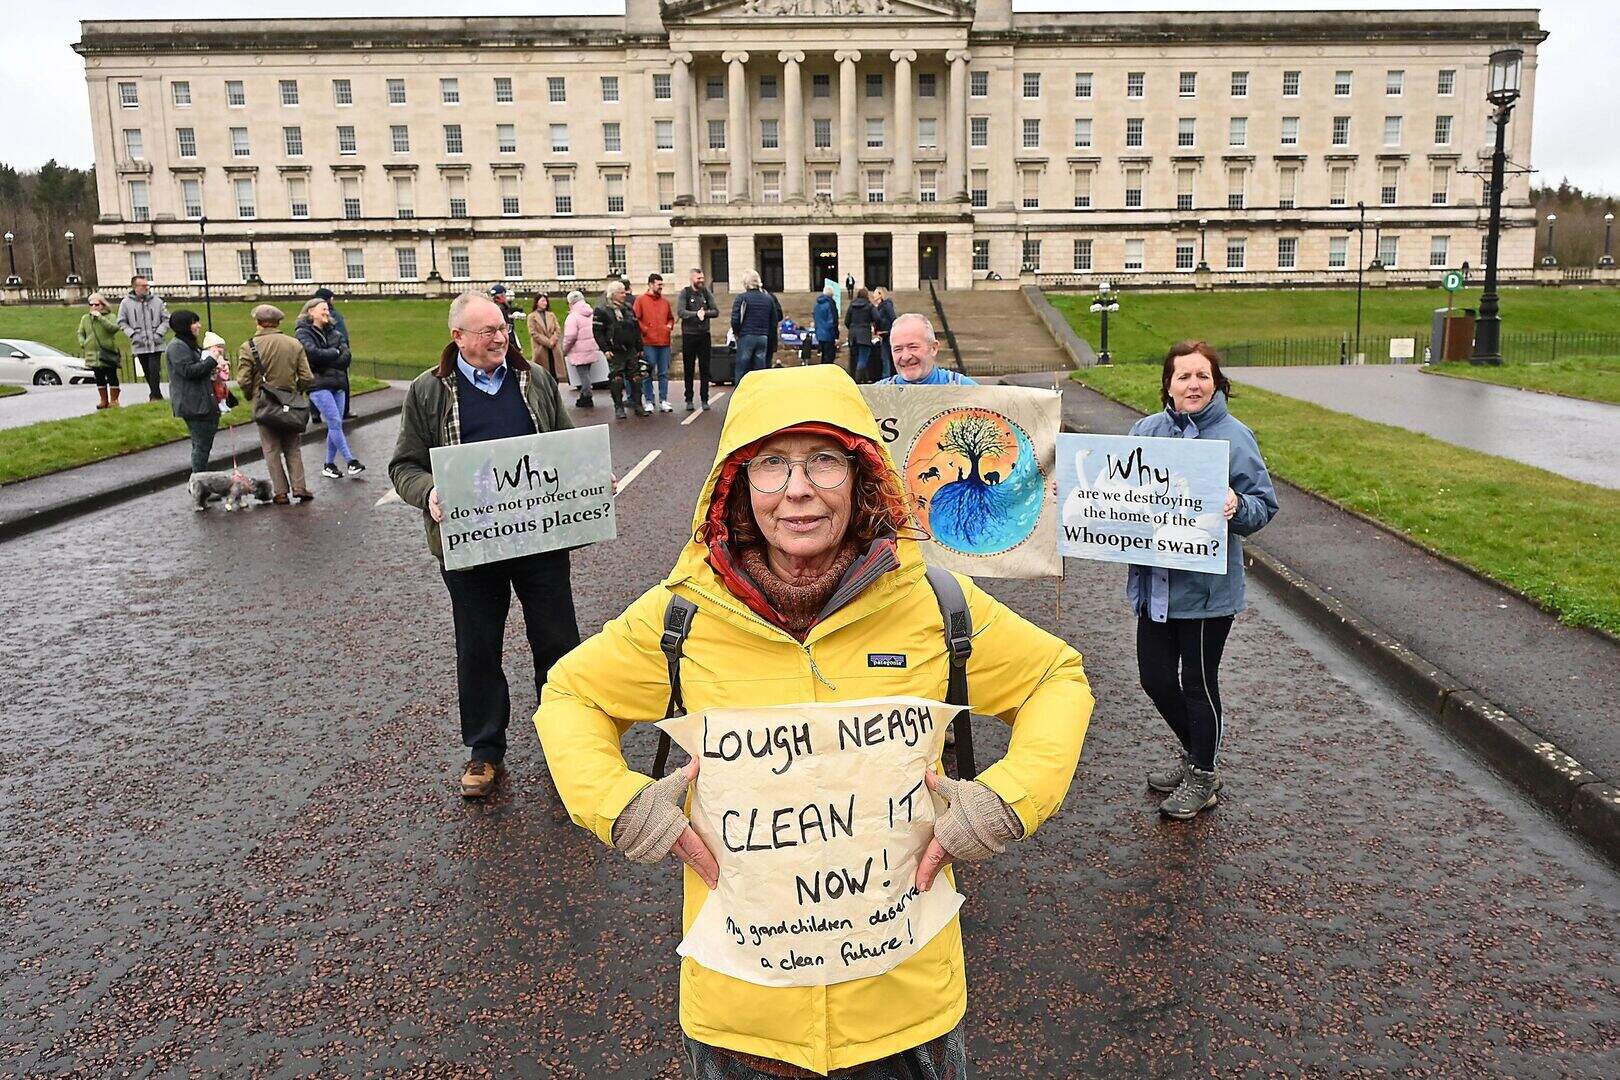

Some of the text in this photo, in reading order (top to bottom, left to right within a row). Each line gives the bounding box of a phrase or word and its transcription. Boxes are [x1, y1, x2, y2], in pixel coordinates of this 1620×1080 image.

[1447, 274, 1459, 288] D
[493, 454, 559, 496] Why
[1107, 447, 1170, 497] Why
[450, 485, 605, 520] do we not protect our
[1078, 489, 1203, 512] are we destroying
[1083, 505, 1197, 528] the home of the
[447, 502, 611, 551] precious places?
[1063, 525, 1220, 557] Whooper swan?
[703, 706, 933, 775] LOUGH NEAGH
[721, 780, 923, 852] CLEAN IT
[795, 848, 891, 905] NOW!
[749, 915, 853, 946] grandchildren
[760, 957, 773, 969] a
[780, 950, 824, 971] clean
